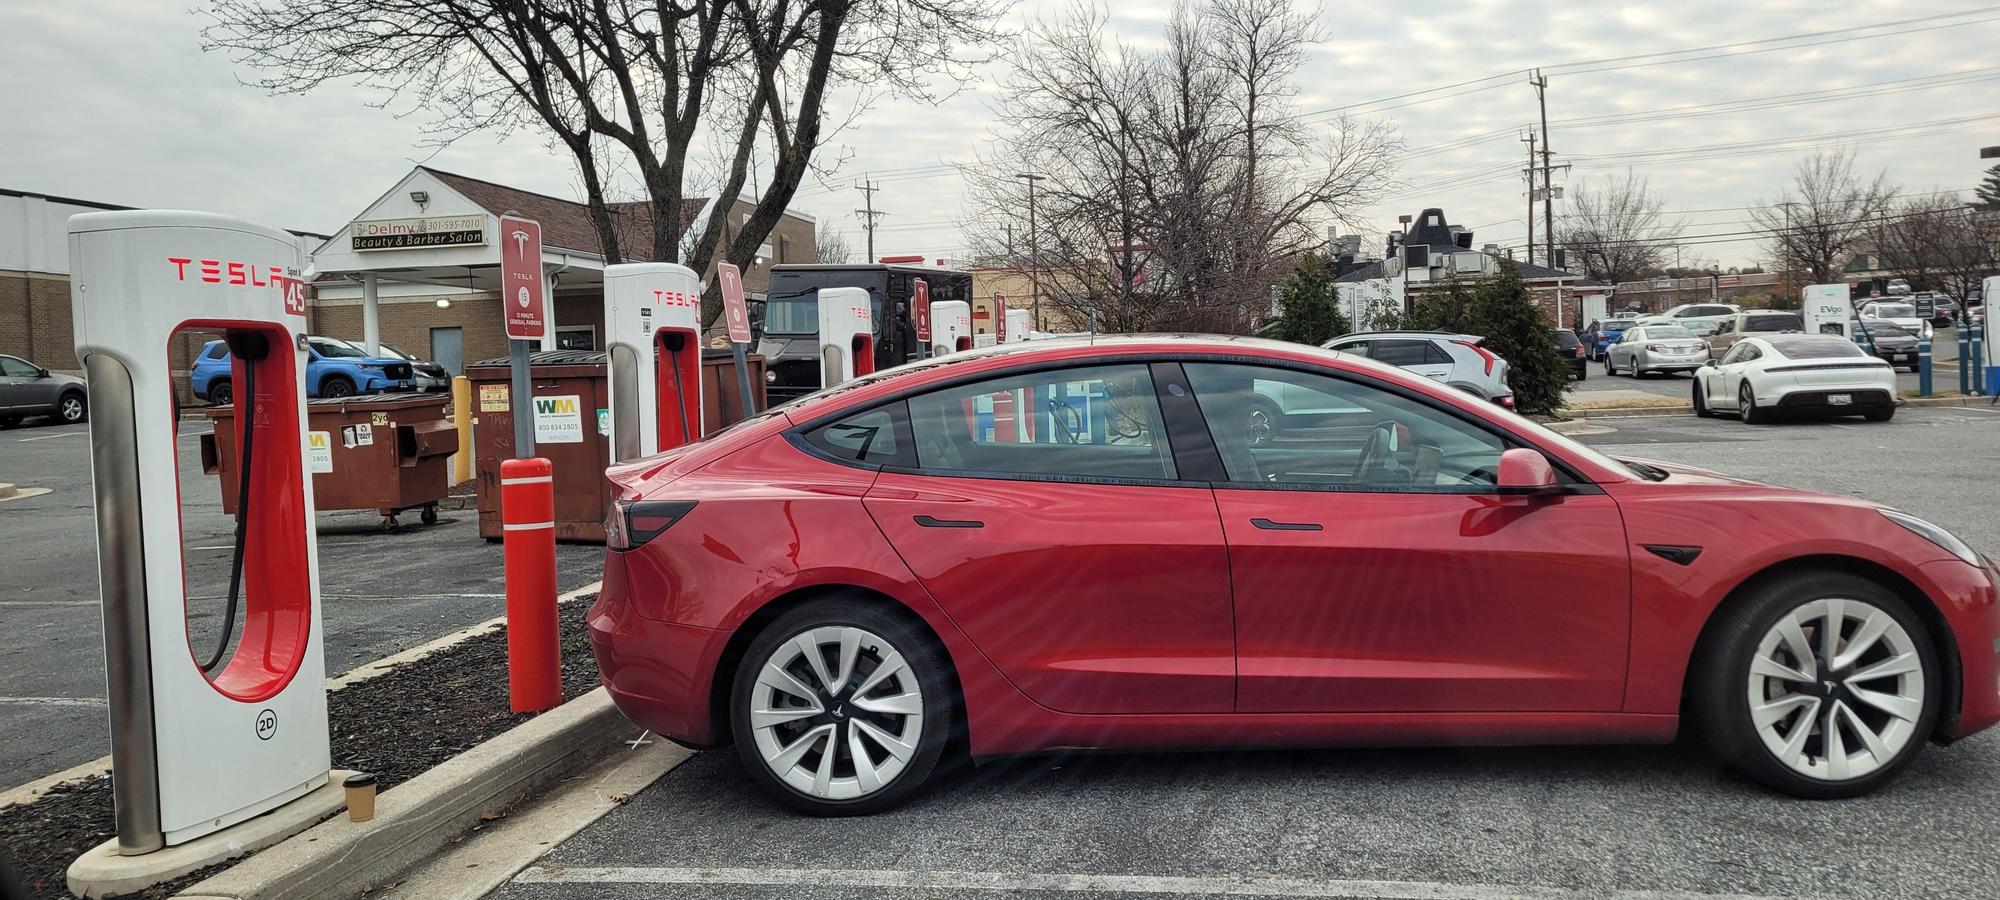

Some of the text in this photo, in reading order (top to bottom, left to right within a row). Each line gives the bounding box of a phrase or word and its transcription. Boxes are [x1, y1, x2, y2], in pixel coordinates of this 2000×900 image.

[368, 219, 480, 235] Delmy 301-595-7010
[354, 231, 481, 248] Beauty & Barber Salon
[167, 257, 284, 288] TESLA
[513, 272, 533, 281] TESLA
[286, 282, 305, 313] 45
[521, 292, 528, 302] 15
[653, 290, 698, 306] TESLA
[1821, 305, 1842, 314] EVgo
[536, 400, 576, 413] WM
[260, 717, 274, 731] 2D
